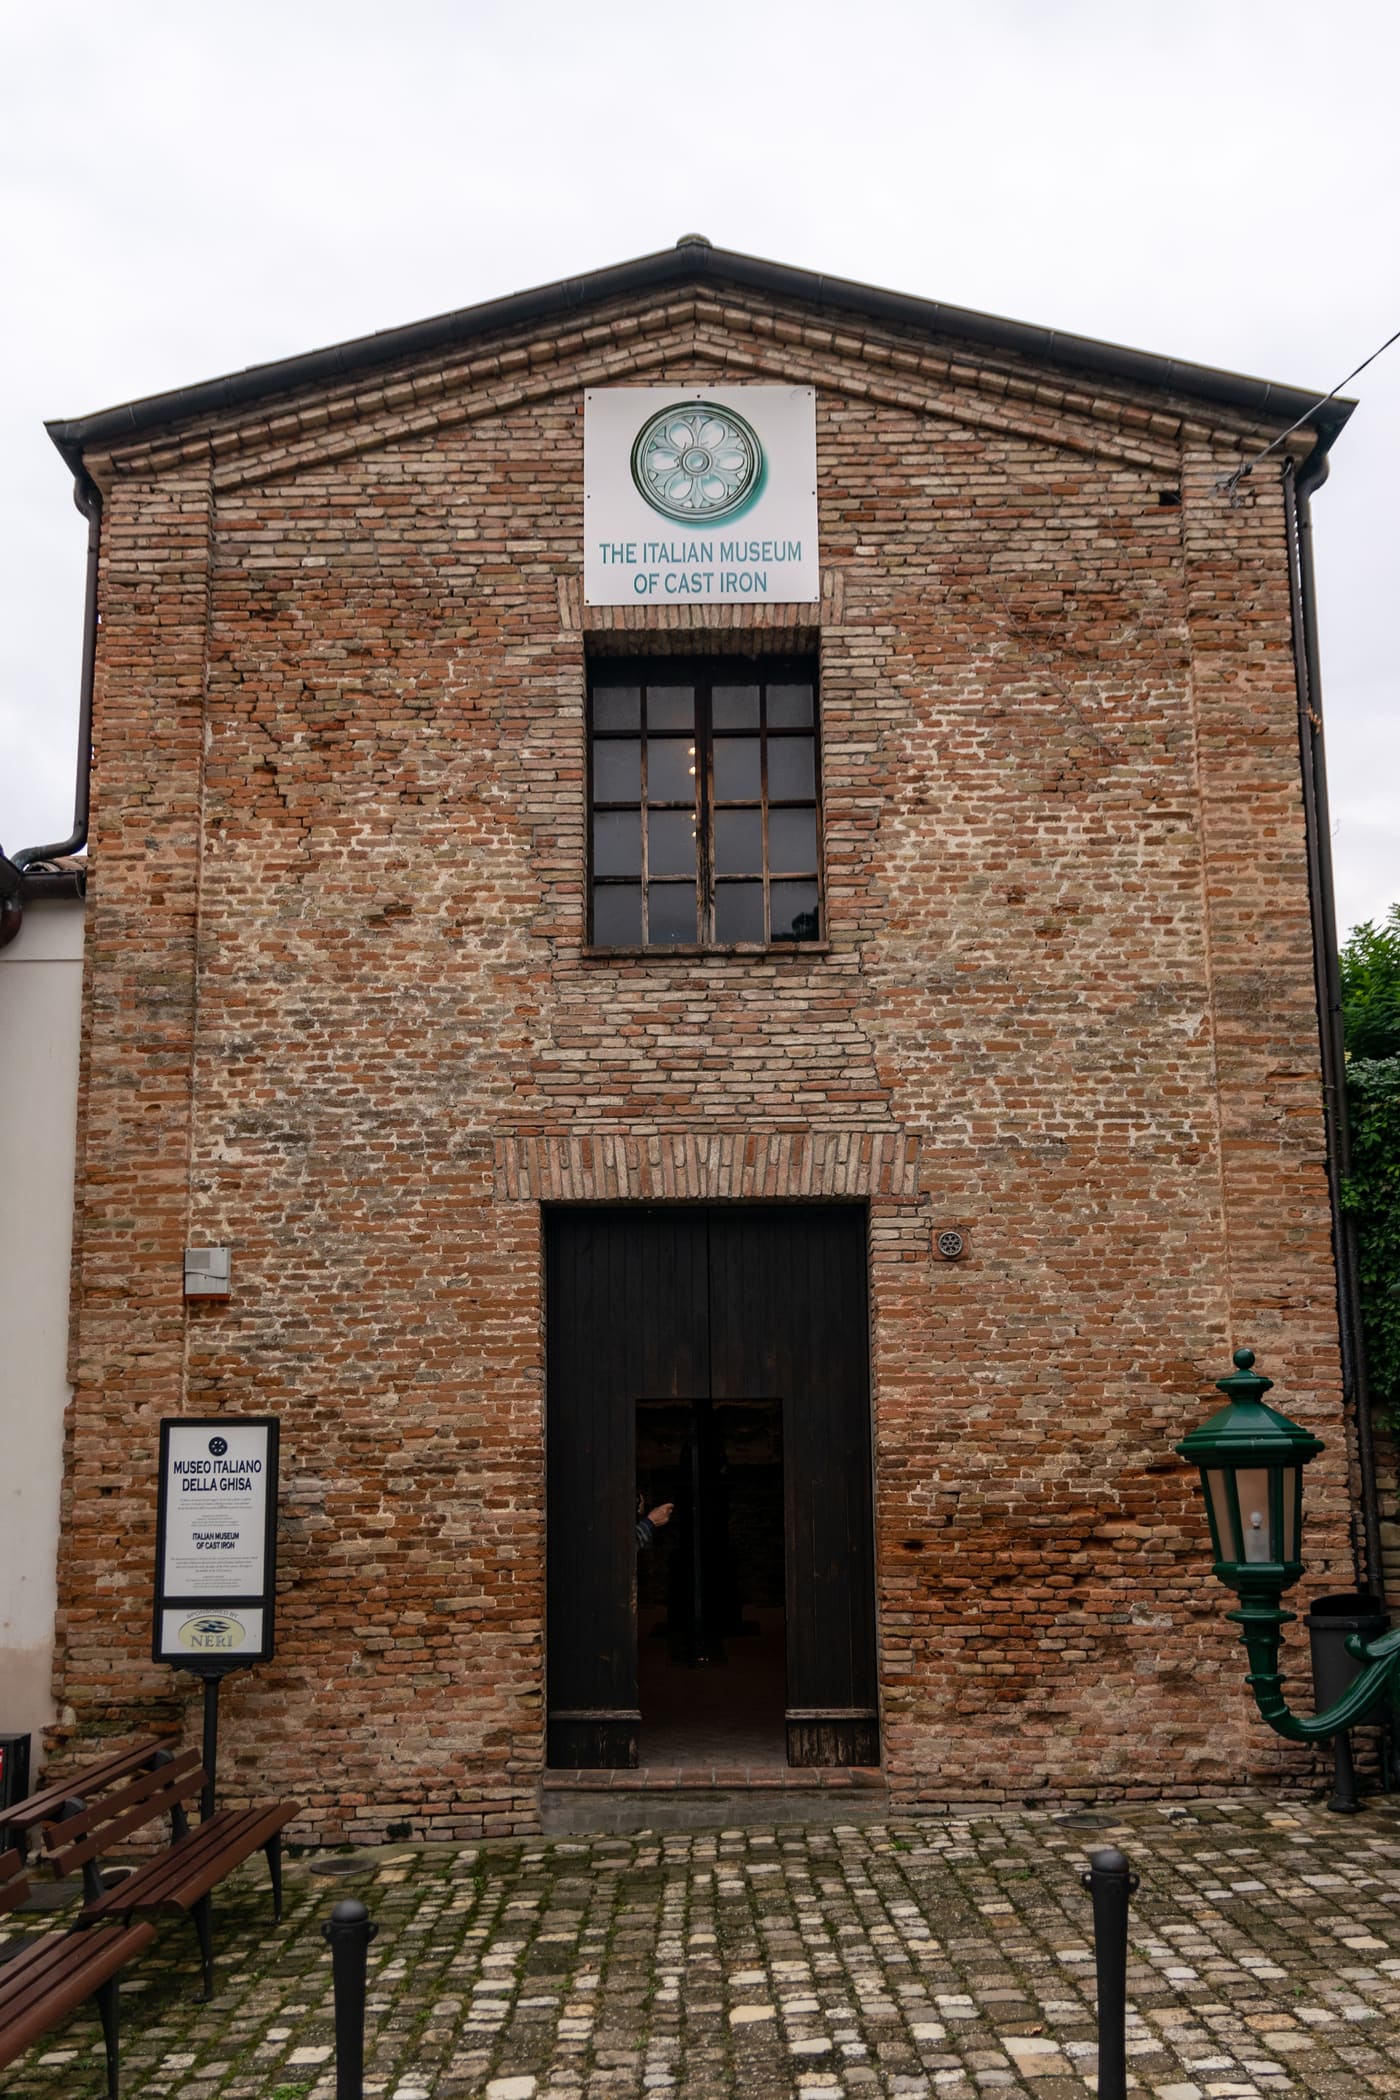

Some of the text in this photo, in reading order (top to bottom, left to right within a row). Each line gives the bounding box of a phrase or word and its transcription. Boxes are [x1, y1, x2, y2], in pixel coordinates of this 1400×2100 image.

[599, 541, 802, 564] THE ITALIAN MUSEUM
[633, 572, 767, 594] OF CAST IRON
[173, 1460, 262, 1474] MUSEO ITALIANO
[182, 1477, 252, 1491] DELLA GHISA
[192, 1532, 239, 1541] ITALIAN MUSEUM
[196, 1542, 204, 1550] OF
[220, 1541, 235, 1549] IRON
[190, 1634, 233, 1648] NERI
